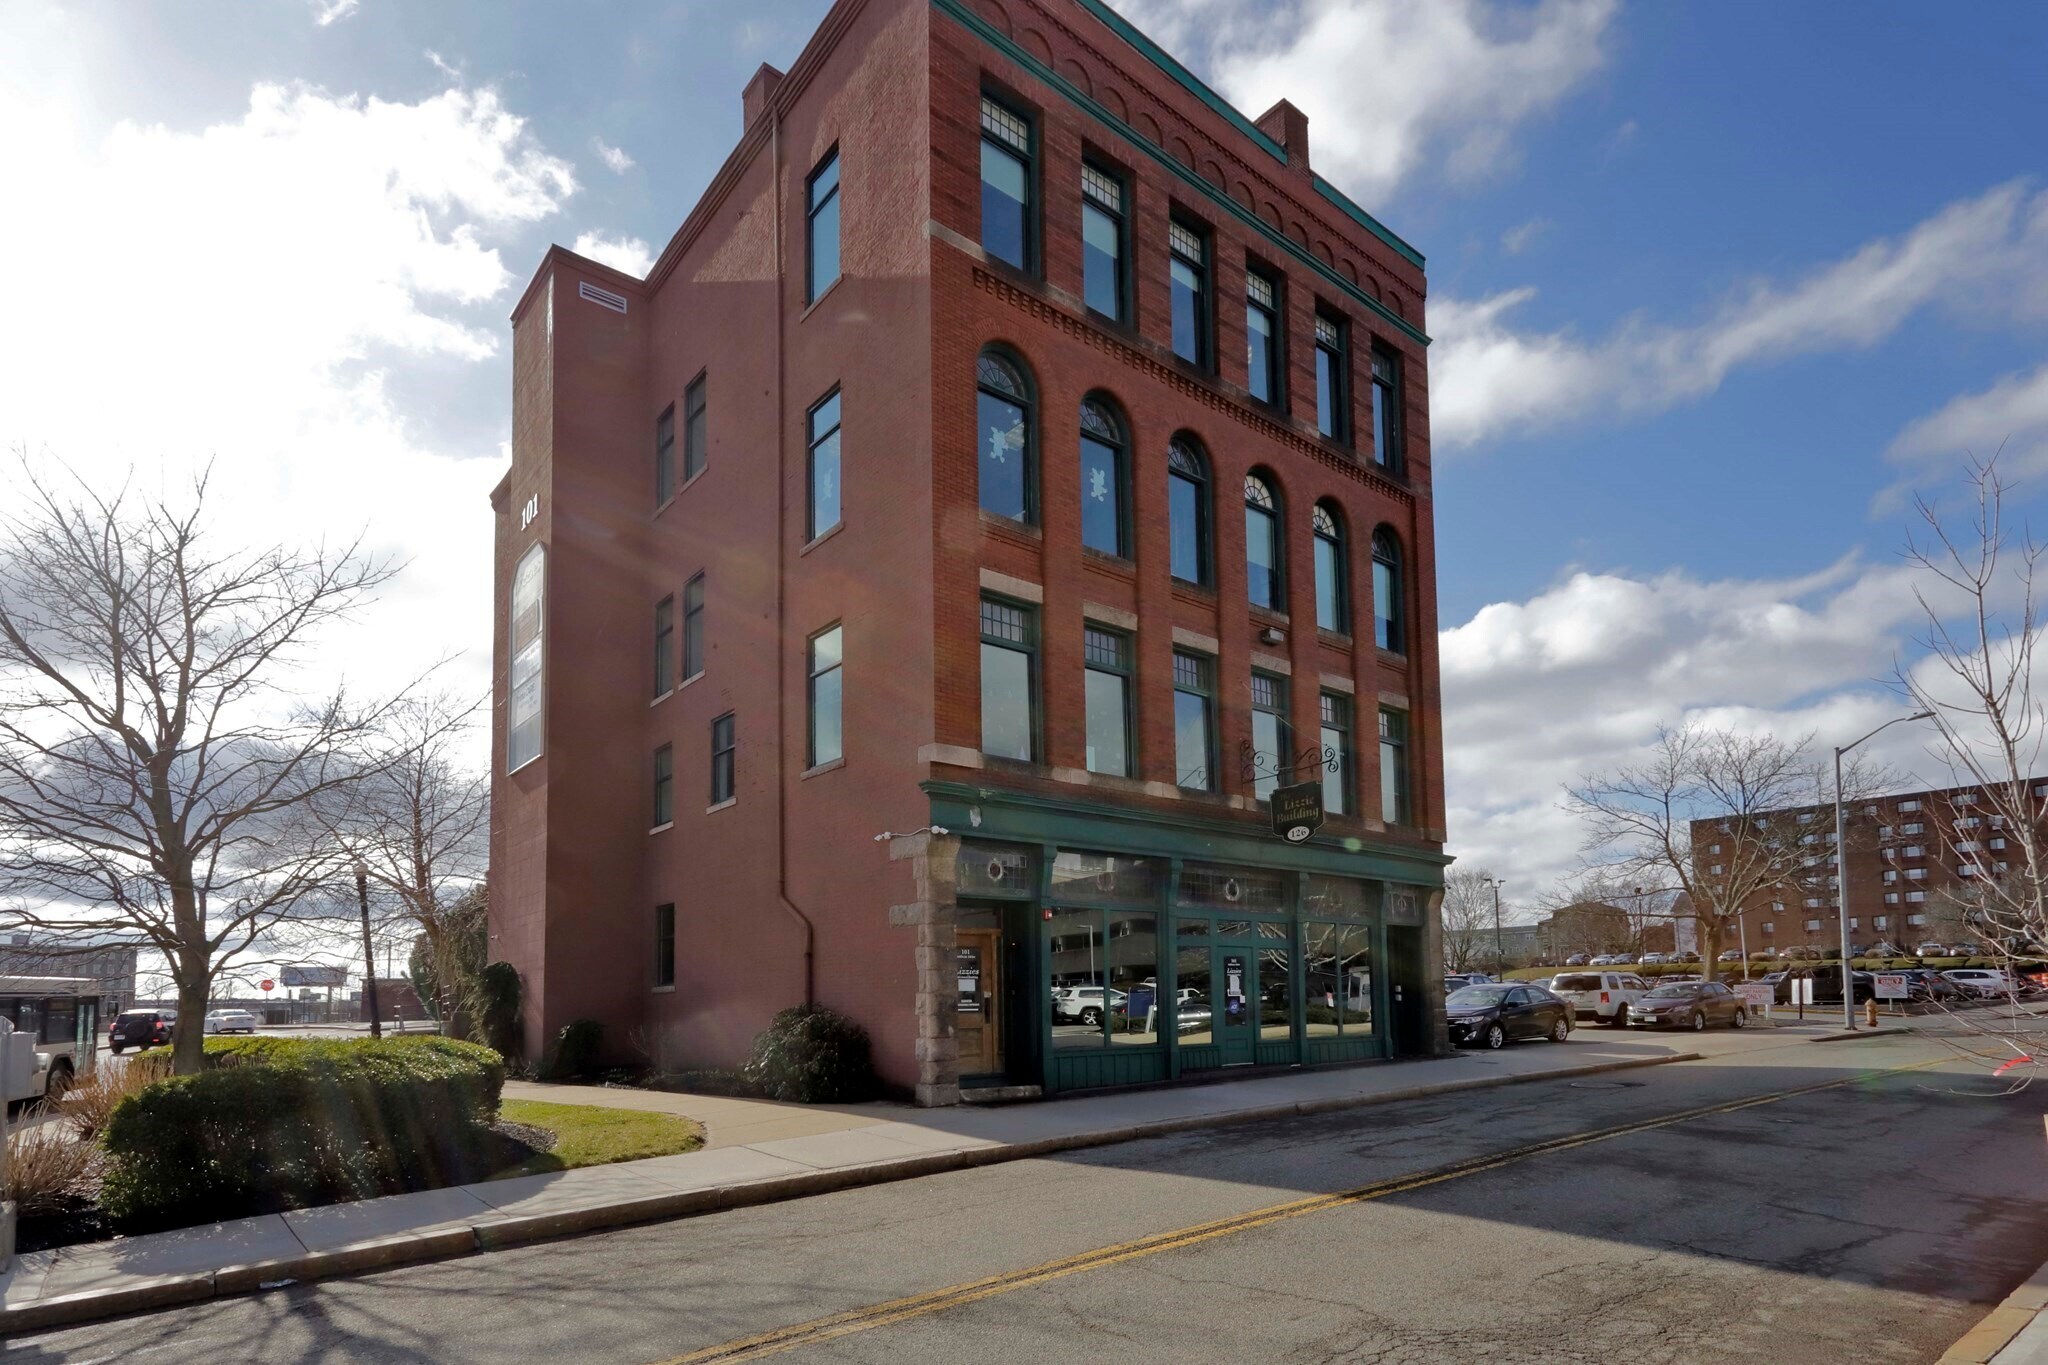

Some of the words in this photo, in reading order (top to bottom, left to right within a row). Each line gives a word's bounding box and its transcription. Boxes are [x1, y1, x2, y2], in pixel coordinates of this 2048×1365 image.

[520, 492, 539, 532] 101
[1284, 795, 1314, 810] Lizzie
[1277, 808, 1319, 824] Building
[1291, 828, 1306, 838] 126
[957, 967, 979, 975] izzies
